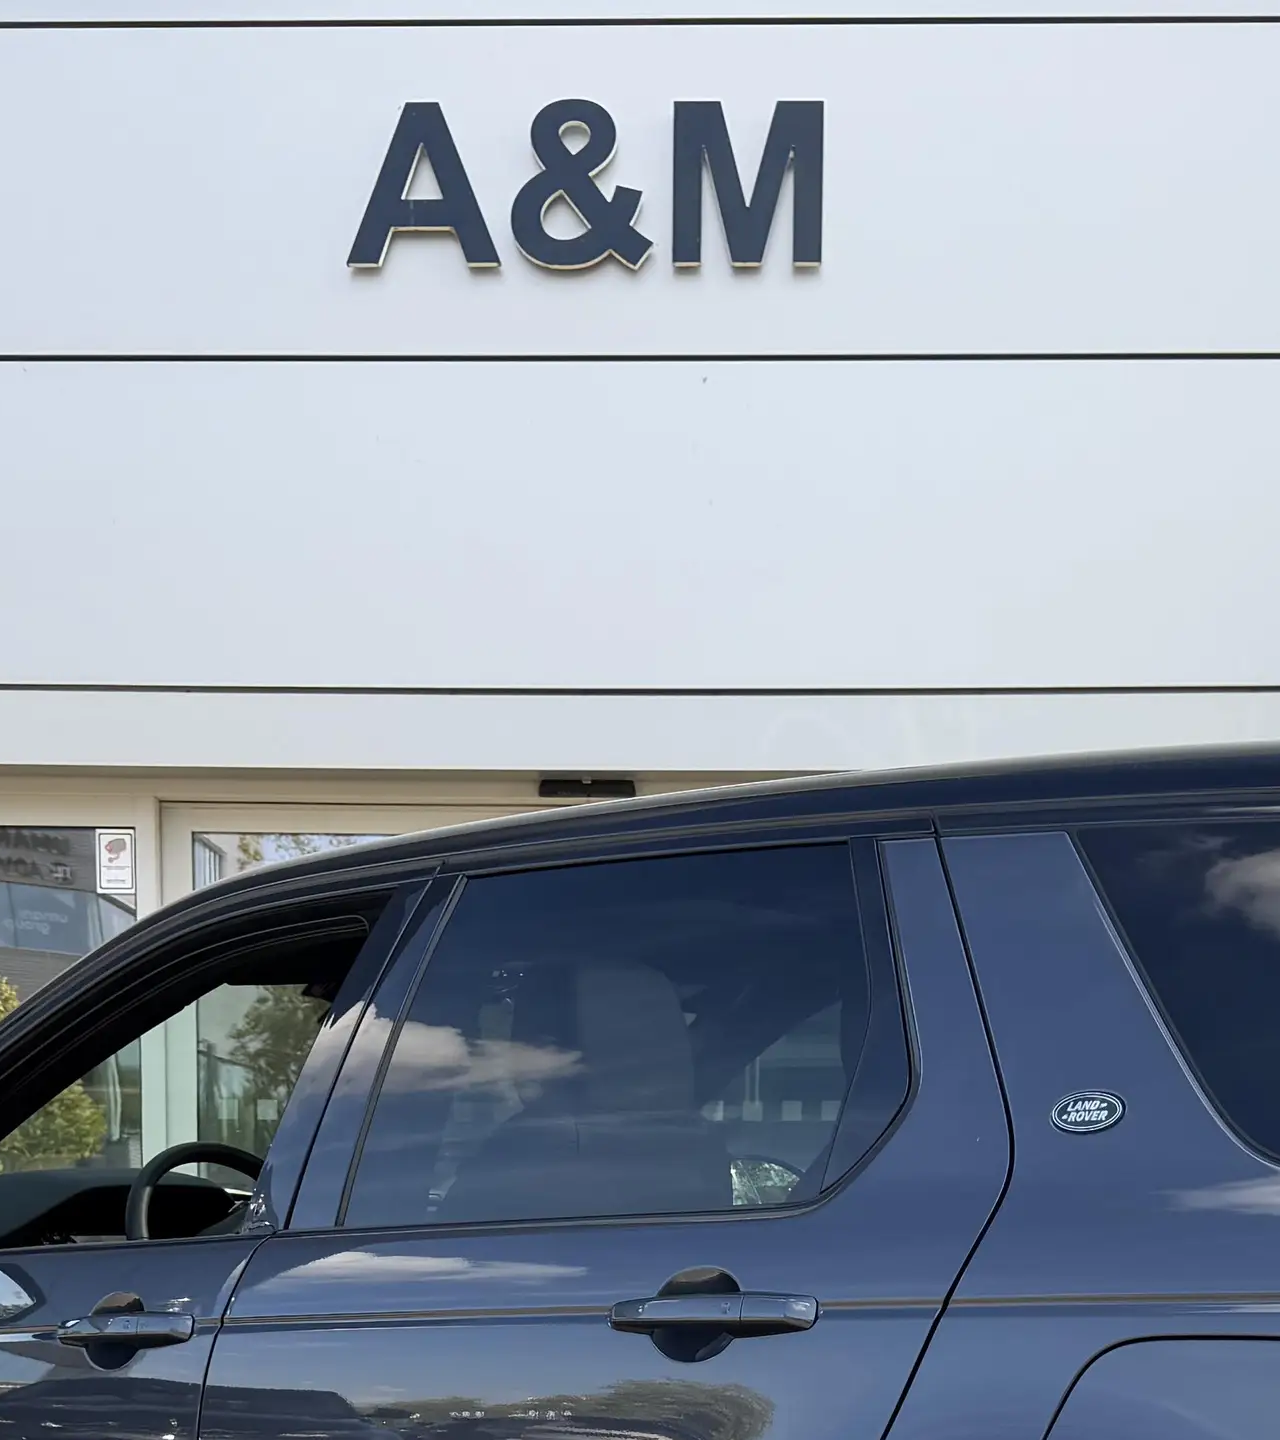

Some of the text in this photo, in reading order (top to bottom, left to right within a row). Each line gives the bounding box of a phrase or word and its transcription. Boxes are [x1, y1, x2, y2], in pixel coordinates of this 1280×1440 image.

[346, 98, 824, 271] A&M
[1067, 1100, 1100, 1112] LAND
[1067, 1110, 1109, 1122] ROVER
